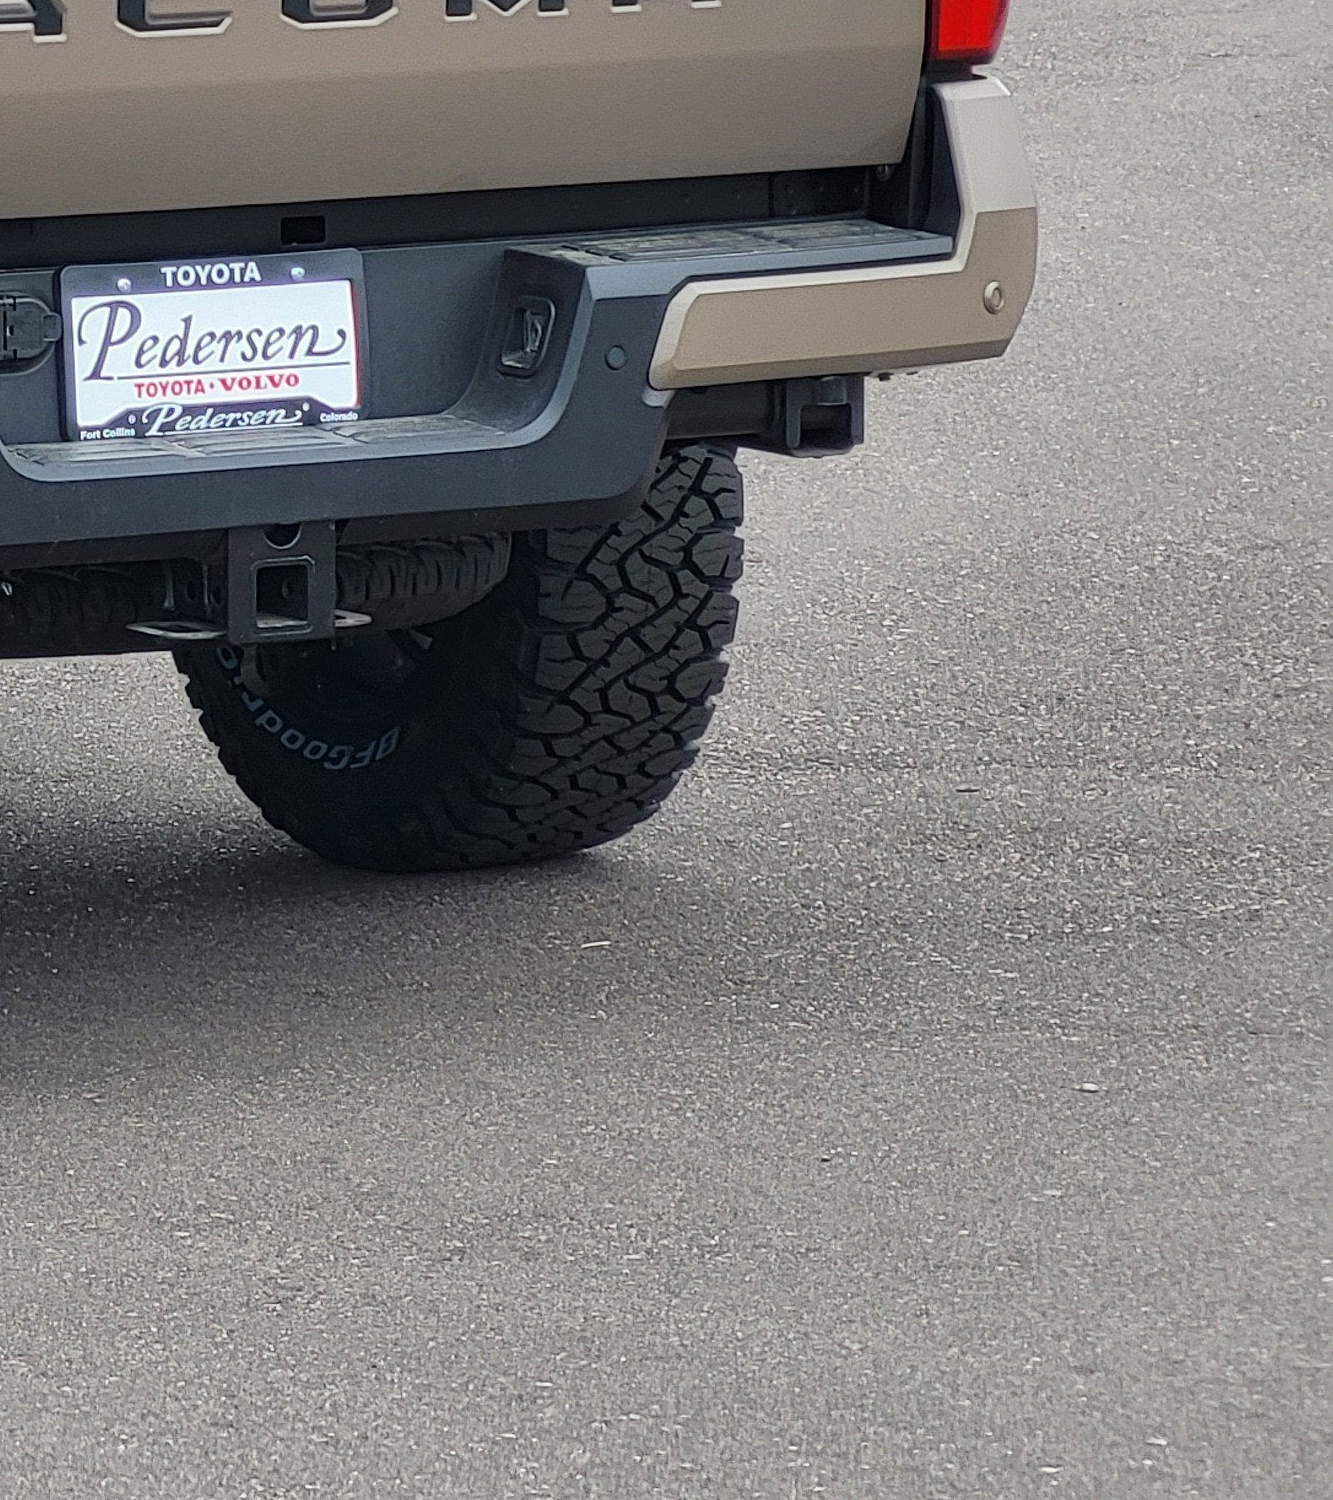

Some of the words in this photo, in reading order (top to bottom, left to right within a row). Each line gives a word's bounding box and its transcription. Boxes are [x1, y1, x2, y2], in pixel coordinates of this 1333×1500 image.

[161, 261, 262, 287] TOYOTA
[77, 300, 347, 382] Pedersen
[134, 379, 206, 399] TOYOTA
[219, 373, 300, 393] VOLVO
[141, 403, 304, 437] Pedersen
[319, 410, 359, 423] Colorado
[80, 431, 101, 440] Fort
